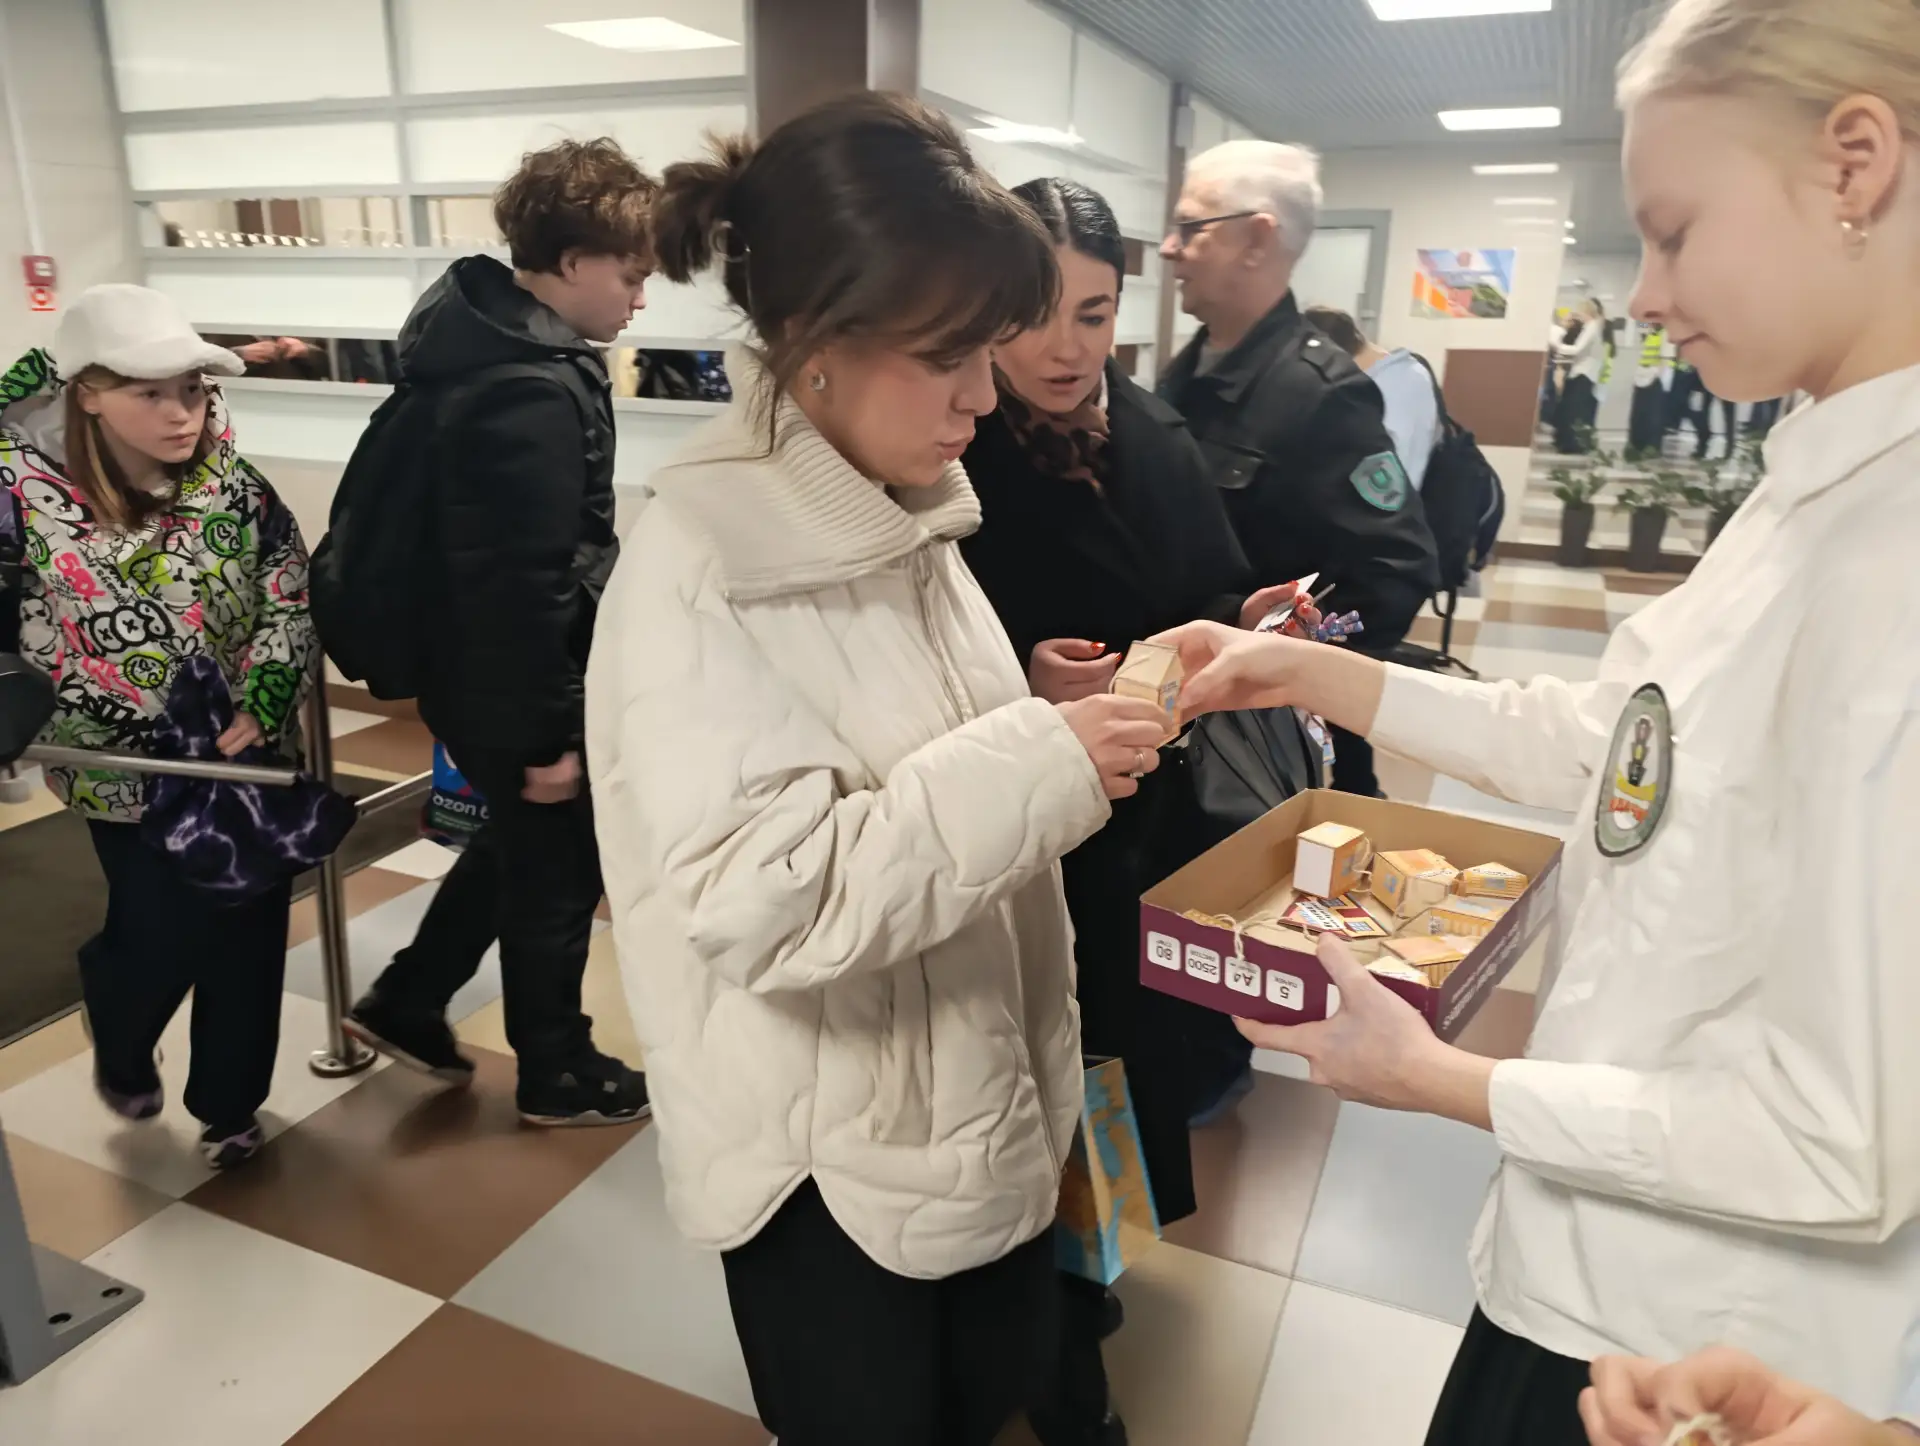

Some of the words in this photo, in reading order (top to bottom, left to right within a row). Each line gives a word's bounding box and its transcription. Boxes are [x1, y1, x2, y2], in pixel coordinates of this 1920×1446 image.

[432, 794, 477, 817] ozon
[1156, 945, 1173, 961] 80
[1188, 958, 1218, 976] 2500
[1280, 986, 1290, 999] 5
